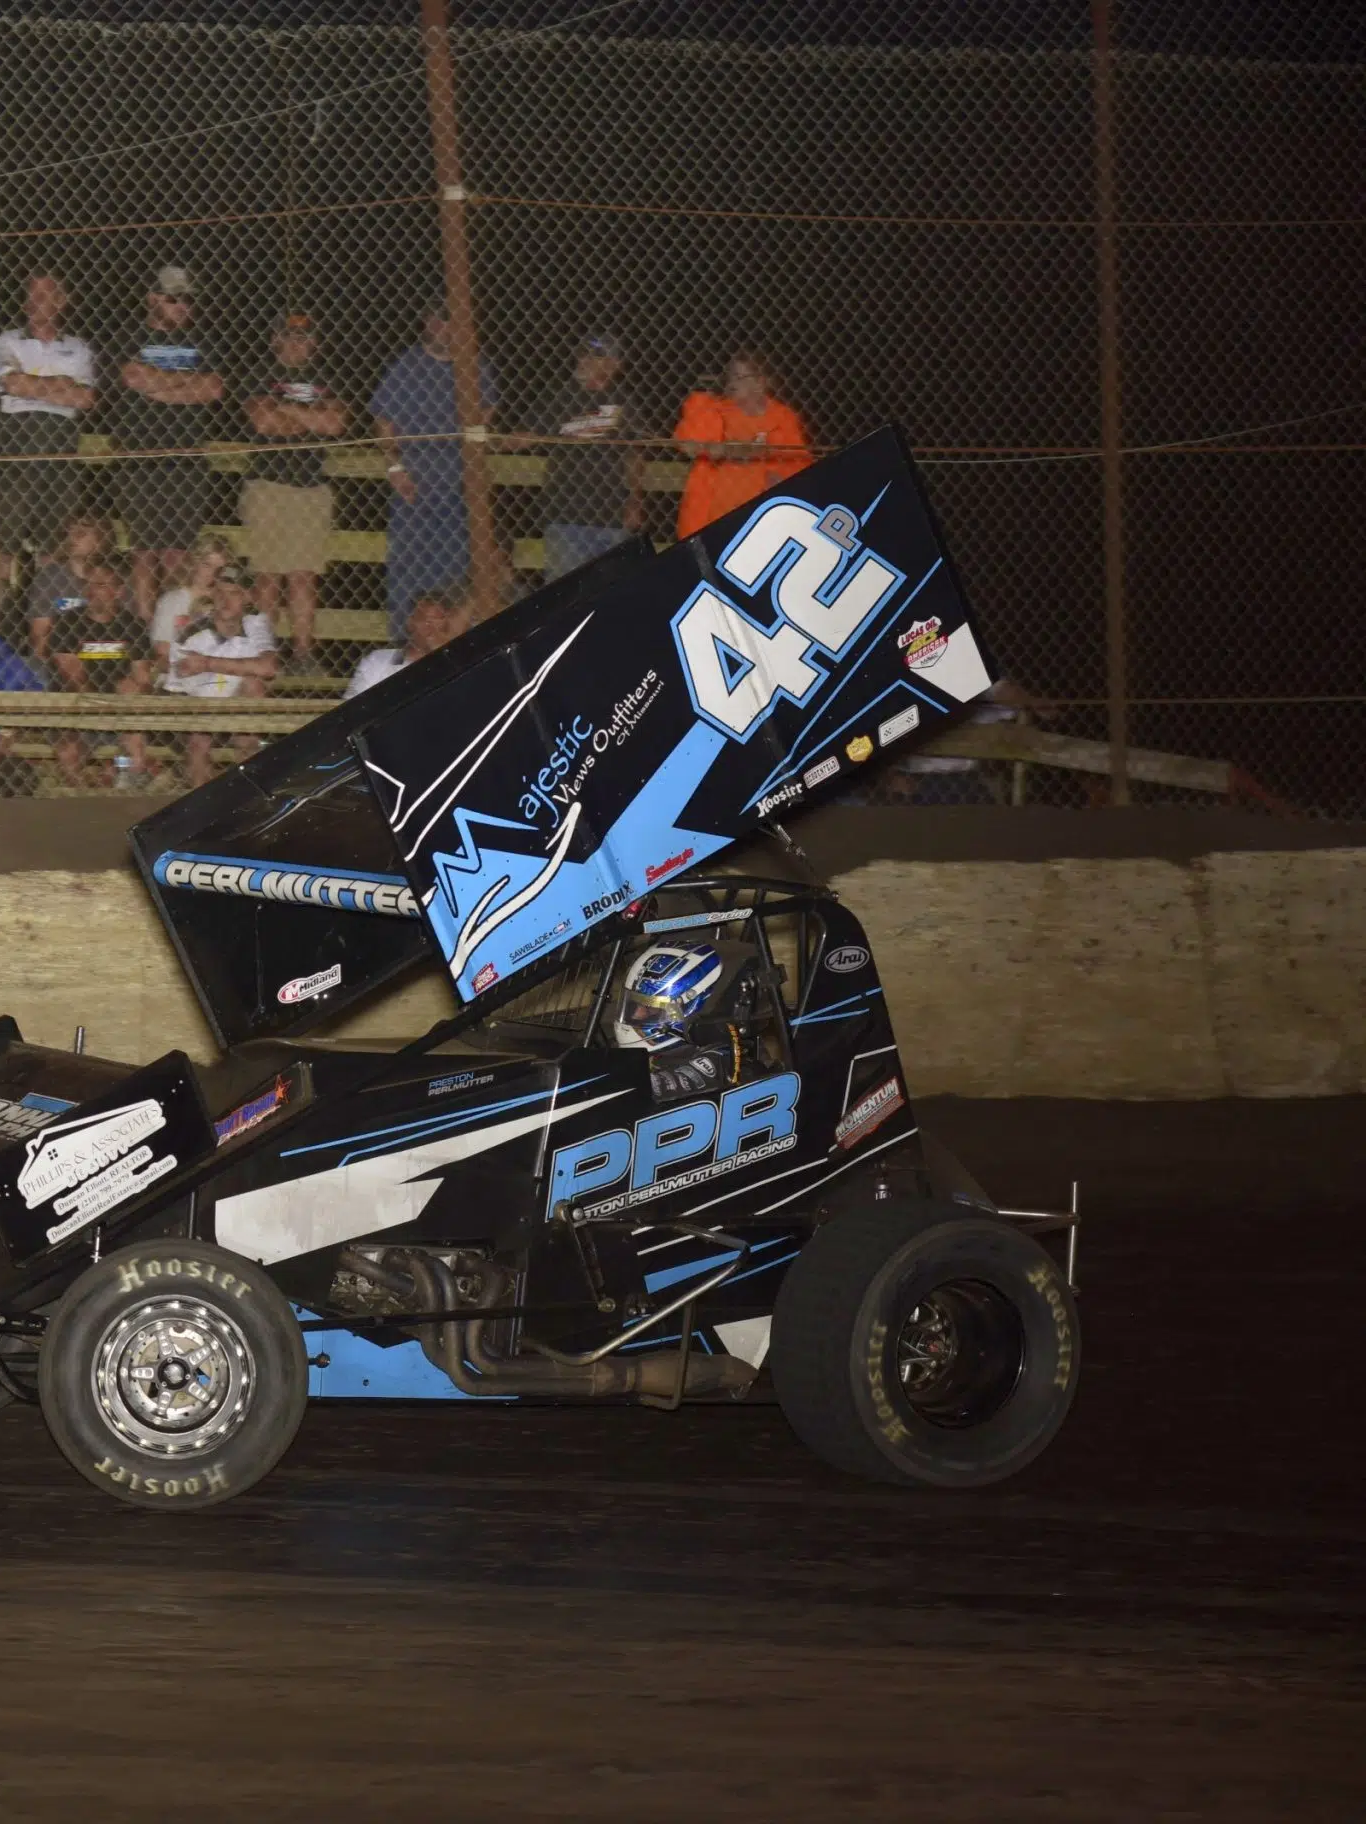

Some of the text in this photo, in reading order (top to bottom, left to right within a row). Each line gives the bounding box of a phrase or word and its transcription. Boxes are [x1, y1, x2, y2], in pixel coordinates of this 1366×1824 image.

[900, 626, 924, 646] LUCAS
[925, 618, 938, 632] OIL
[628, 680, 666, 730] Missouri
[552, 669, 657, 804] Views Outfitters
[755, 782, 803, 818] Hoosier
[298, 967, 340, 992] Midland
[827, 949, 864, 967] Arai
[427, 1074, 495, 1097] PERLMUTTER
[429, 1072, 474, 1090] PRESTON
[835, 1077, 899, 1138] MOMENTUM
[22, 1107, 160, 1197] PHILLIPS & ASSOCIATES
[544, 1072, 801, 1223] PPR
[57, 1188, 86, 1211] Duncan
[110, 1150, 150, 1178] REALTOR
[628, 1161, 733, 1205] PERLMUTTER
[735, 1136, 795, 1166] RACING
[115, 1256, 253, 1299] Hoosier
[93, 1456, 231, 1498] Hoosier
